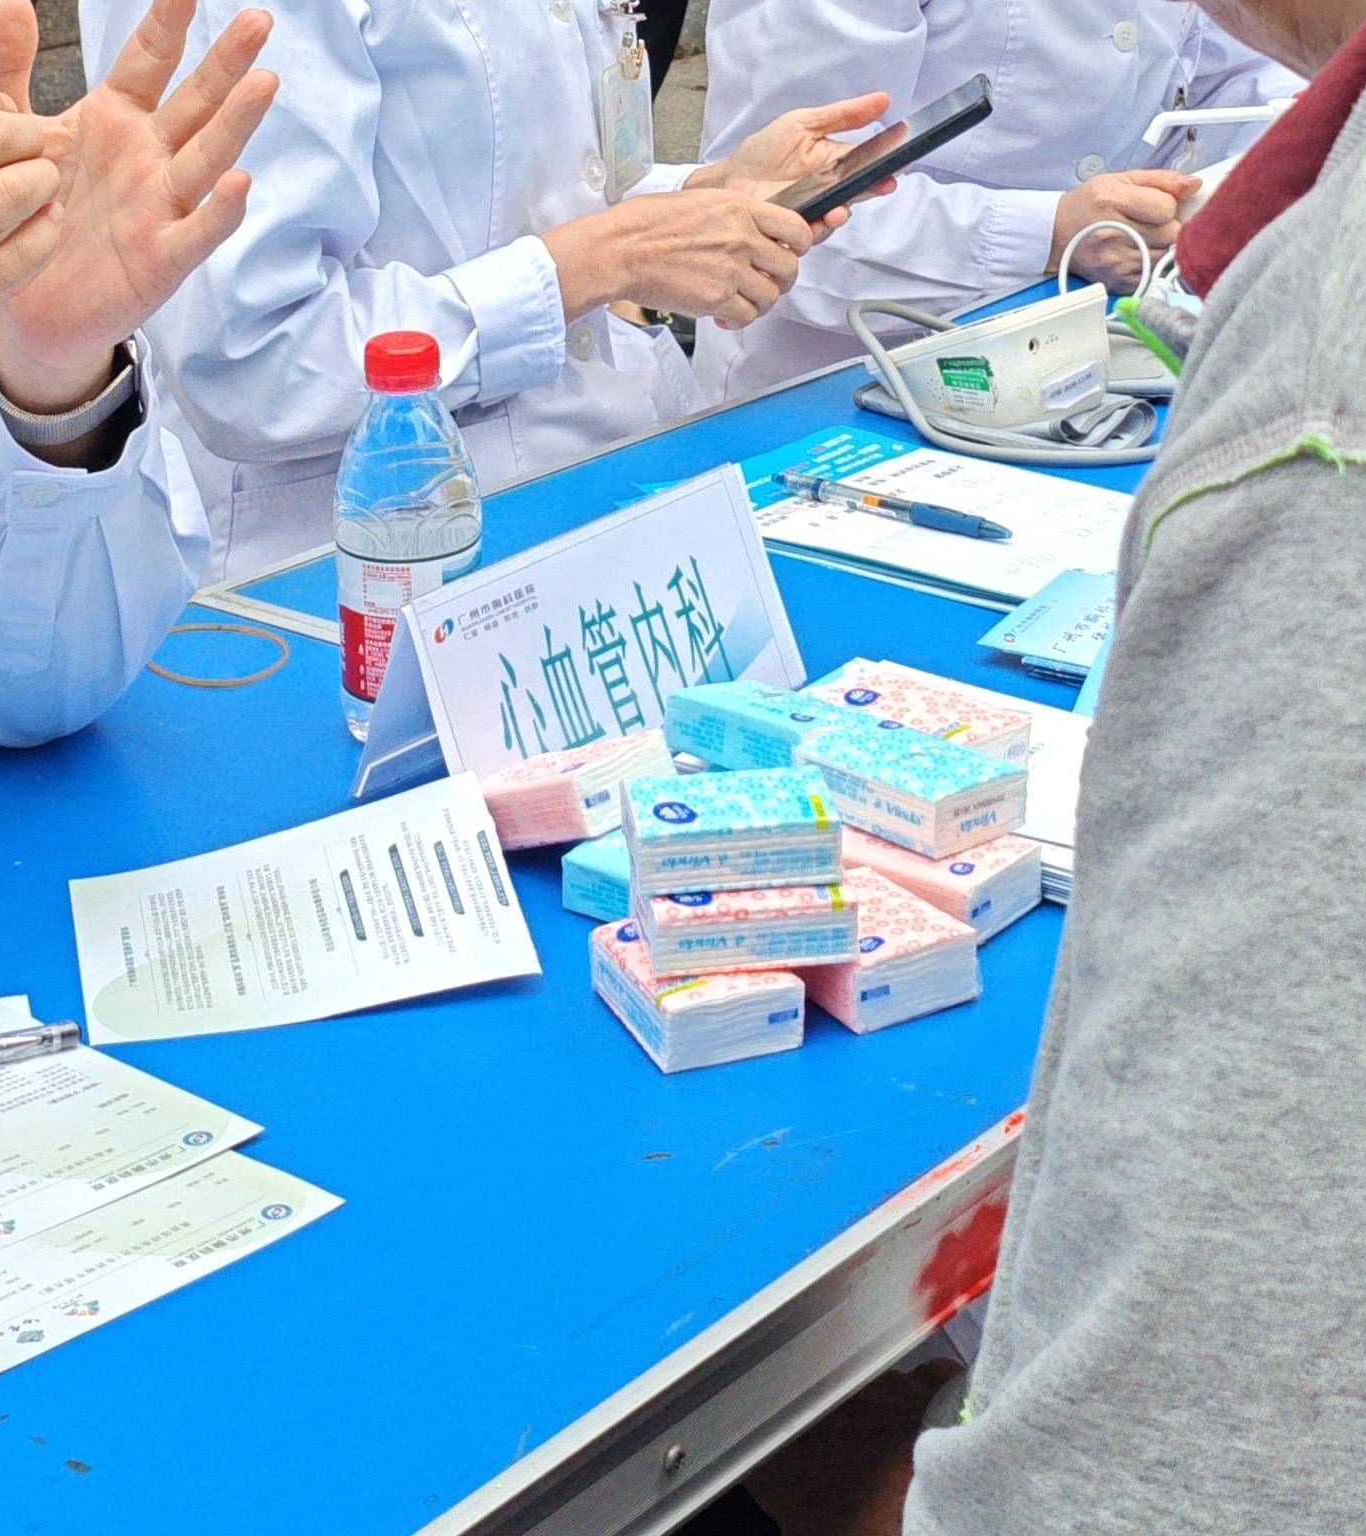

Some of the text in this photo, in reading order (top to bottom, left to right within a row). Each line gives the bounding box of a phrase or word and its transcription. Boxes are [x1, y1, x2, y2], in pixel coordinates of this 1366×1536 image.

[458, 583, 536, 626] 广州市胸科医院
[499, 556, 734, 759] 心血管内科
